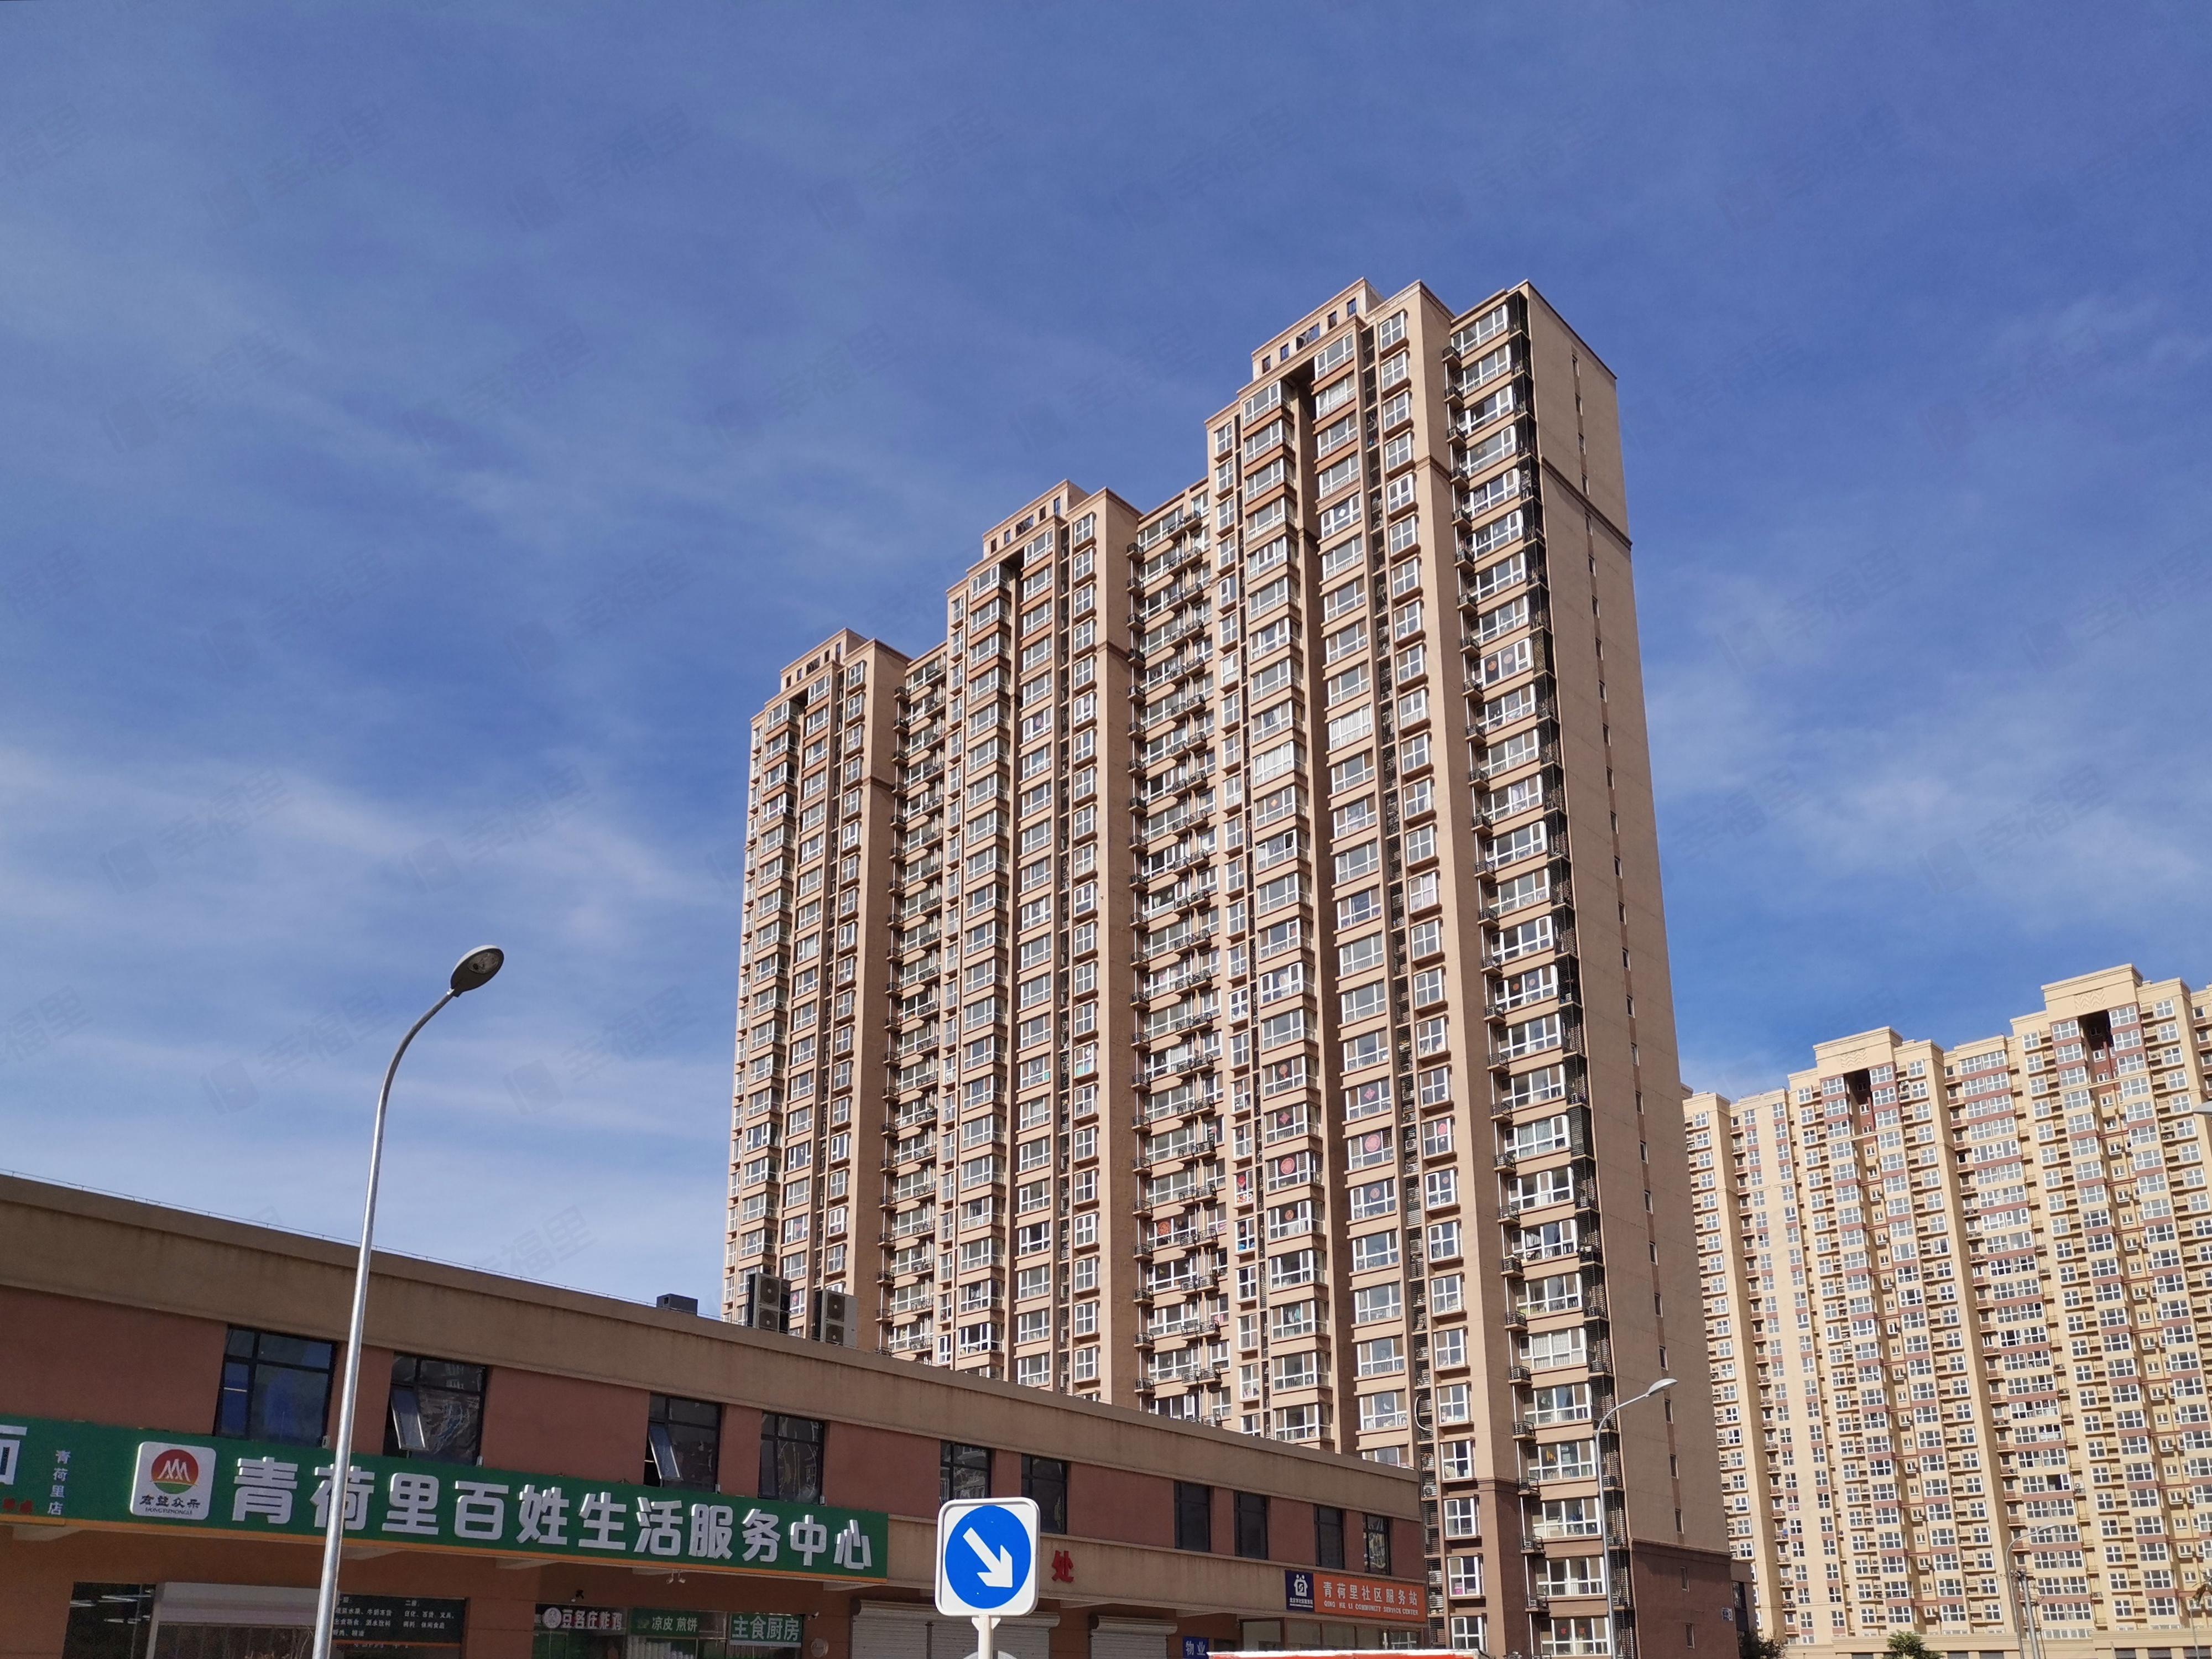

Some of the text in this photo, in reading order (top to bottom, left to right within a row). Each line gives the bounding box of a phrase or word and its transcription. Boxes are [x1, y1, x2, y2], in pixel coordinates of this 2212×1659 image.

[48, 1450, 71, 1515] 青荷里店
[232, 1456, 872, 1571] 青荷里百姓生活服务中心
[1051, 1550, 1074, 1583] 处
[1323, 1582, 1417, 1606] 青荷里社区服务站
[561, 1609, 622, 1631] 豆各庄炸鸡
[1355, 1604, 1381, 1612] COMMUNITY
[651, 1616, 698, 1632] 凉皮 煎饼
[732, 1615, 800, 1641] 主食厨房
[1186, 1640, 1206, 1656] 物业
